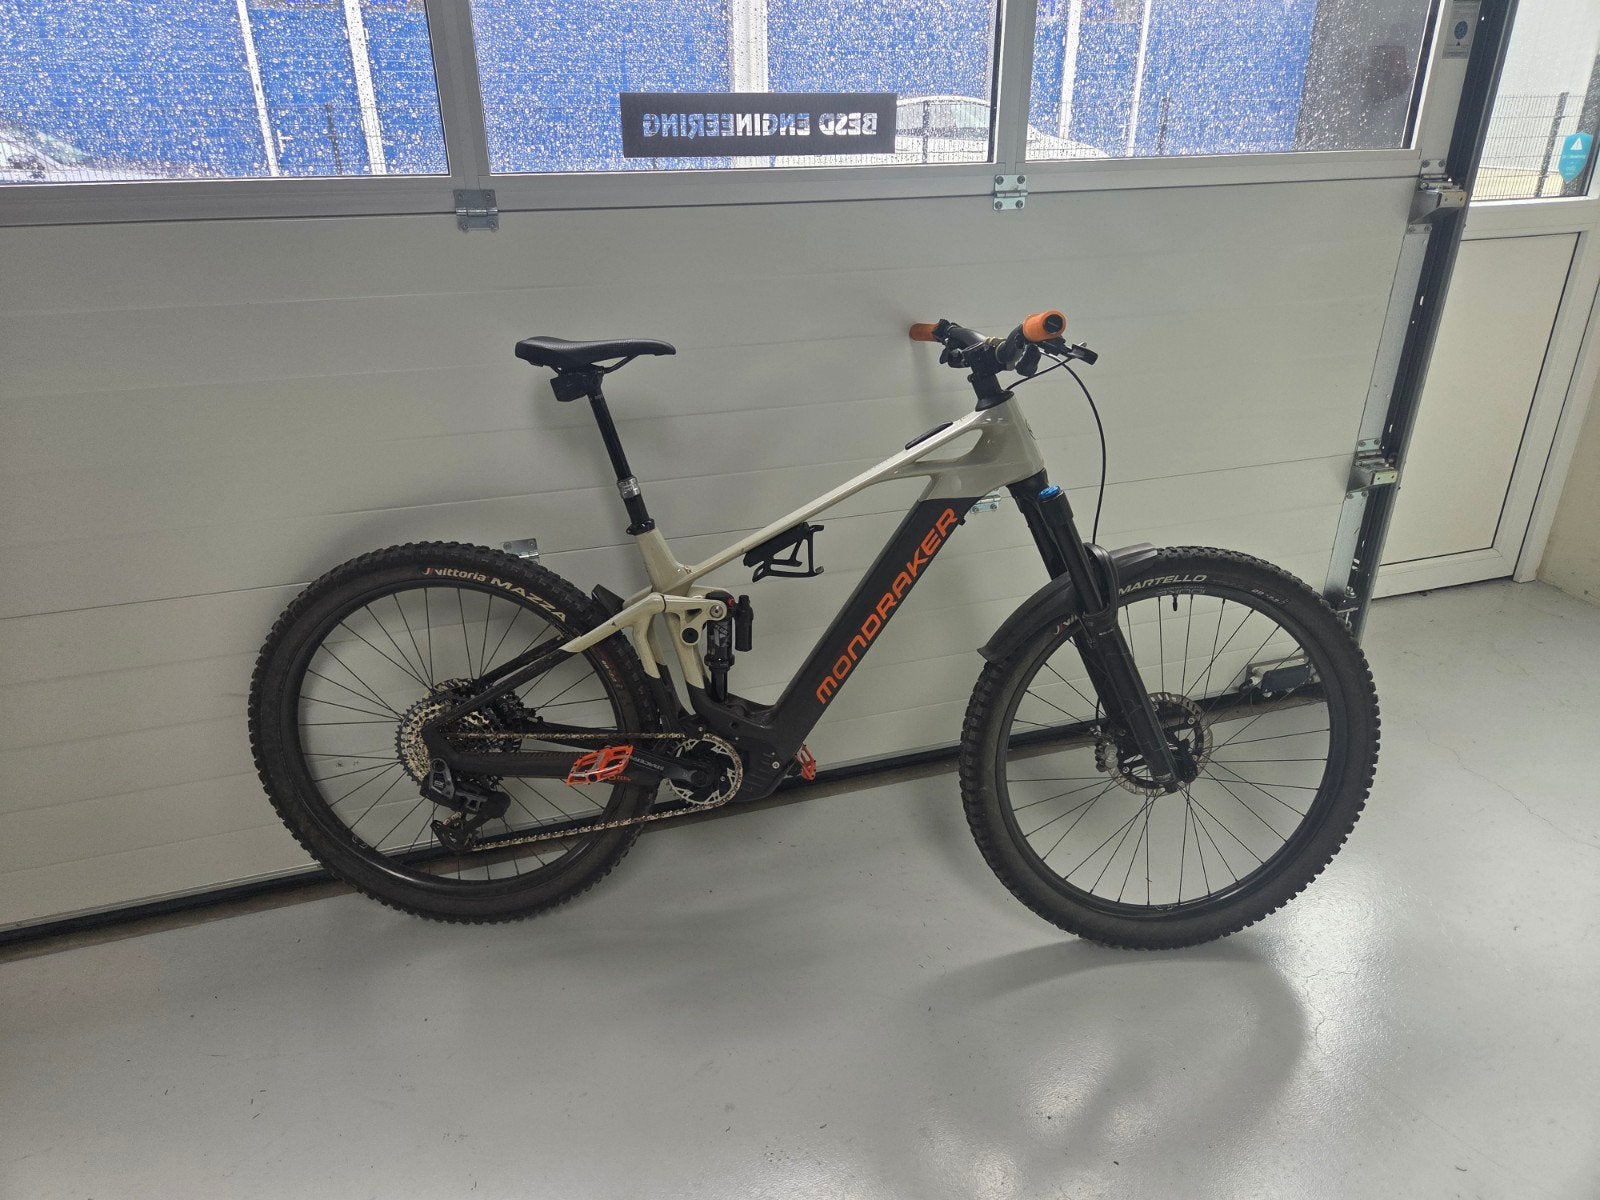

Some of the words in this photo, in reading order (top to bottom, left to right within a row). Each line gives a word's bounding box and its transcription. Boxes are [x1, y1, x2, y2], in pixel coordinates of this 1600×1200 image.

[490, 577, 567, 623] MAZZA
[816, 507, 958, 705] MONDRAKER
[1118, 574, 1208, 596] MARTELLO
